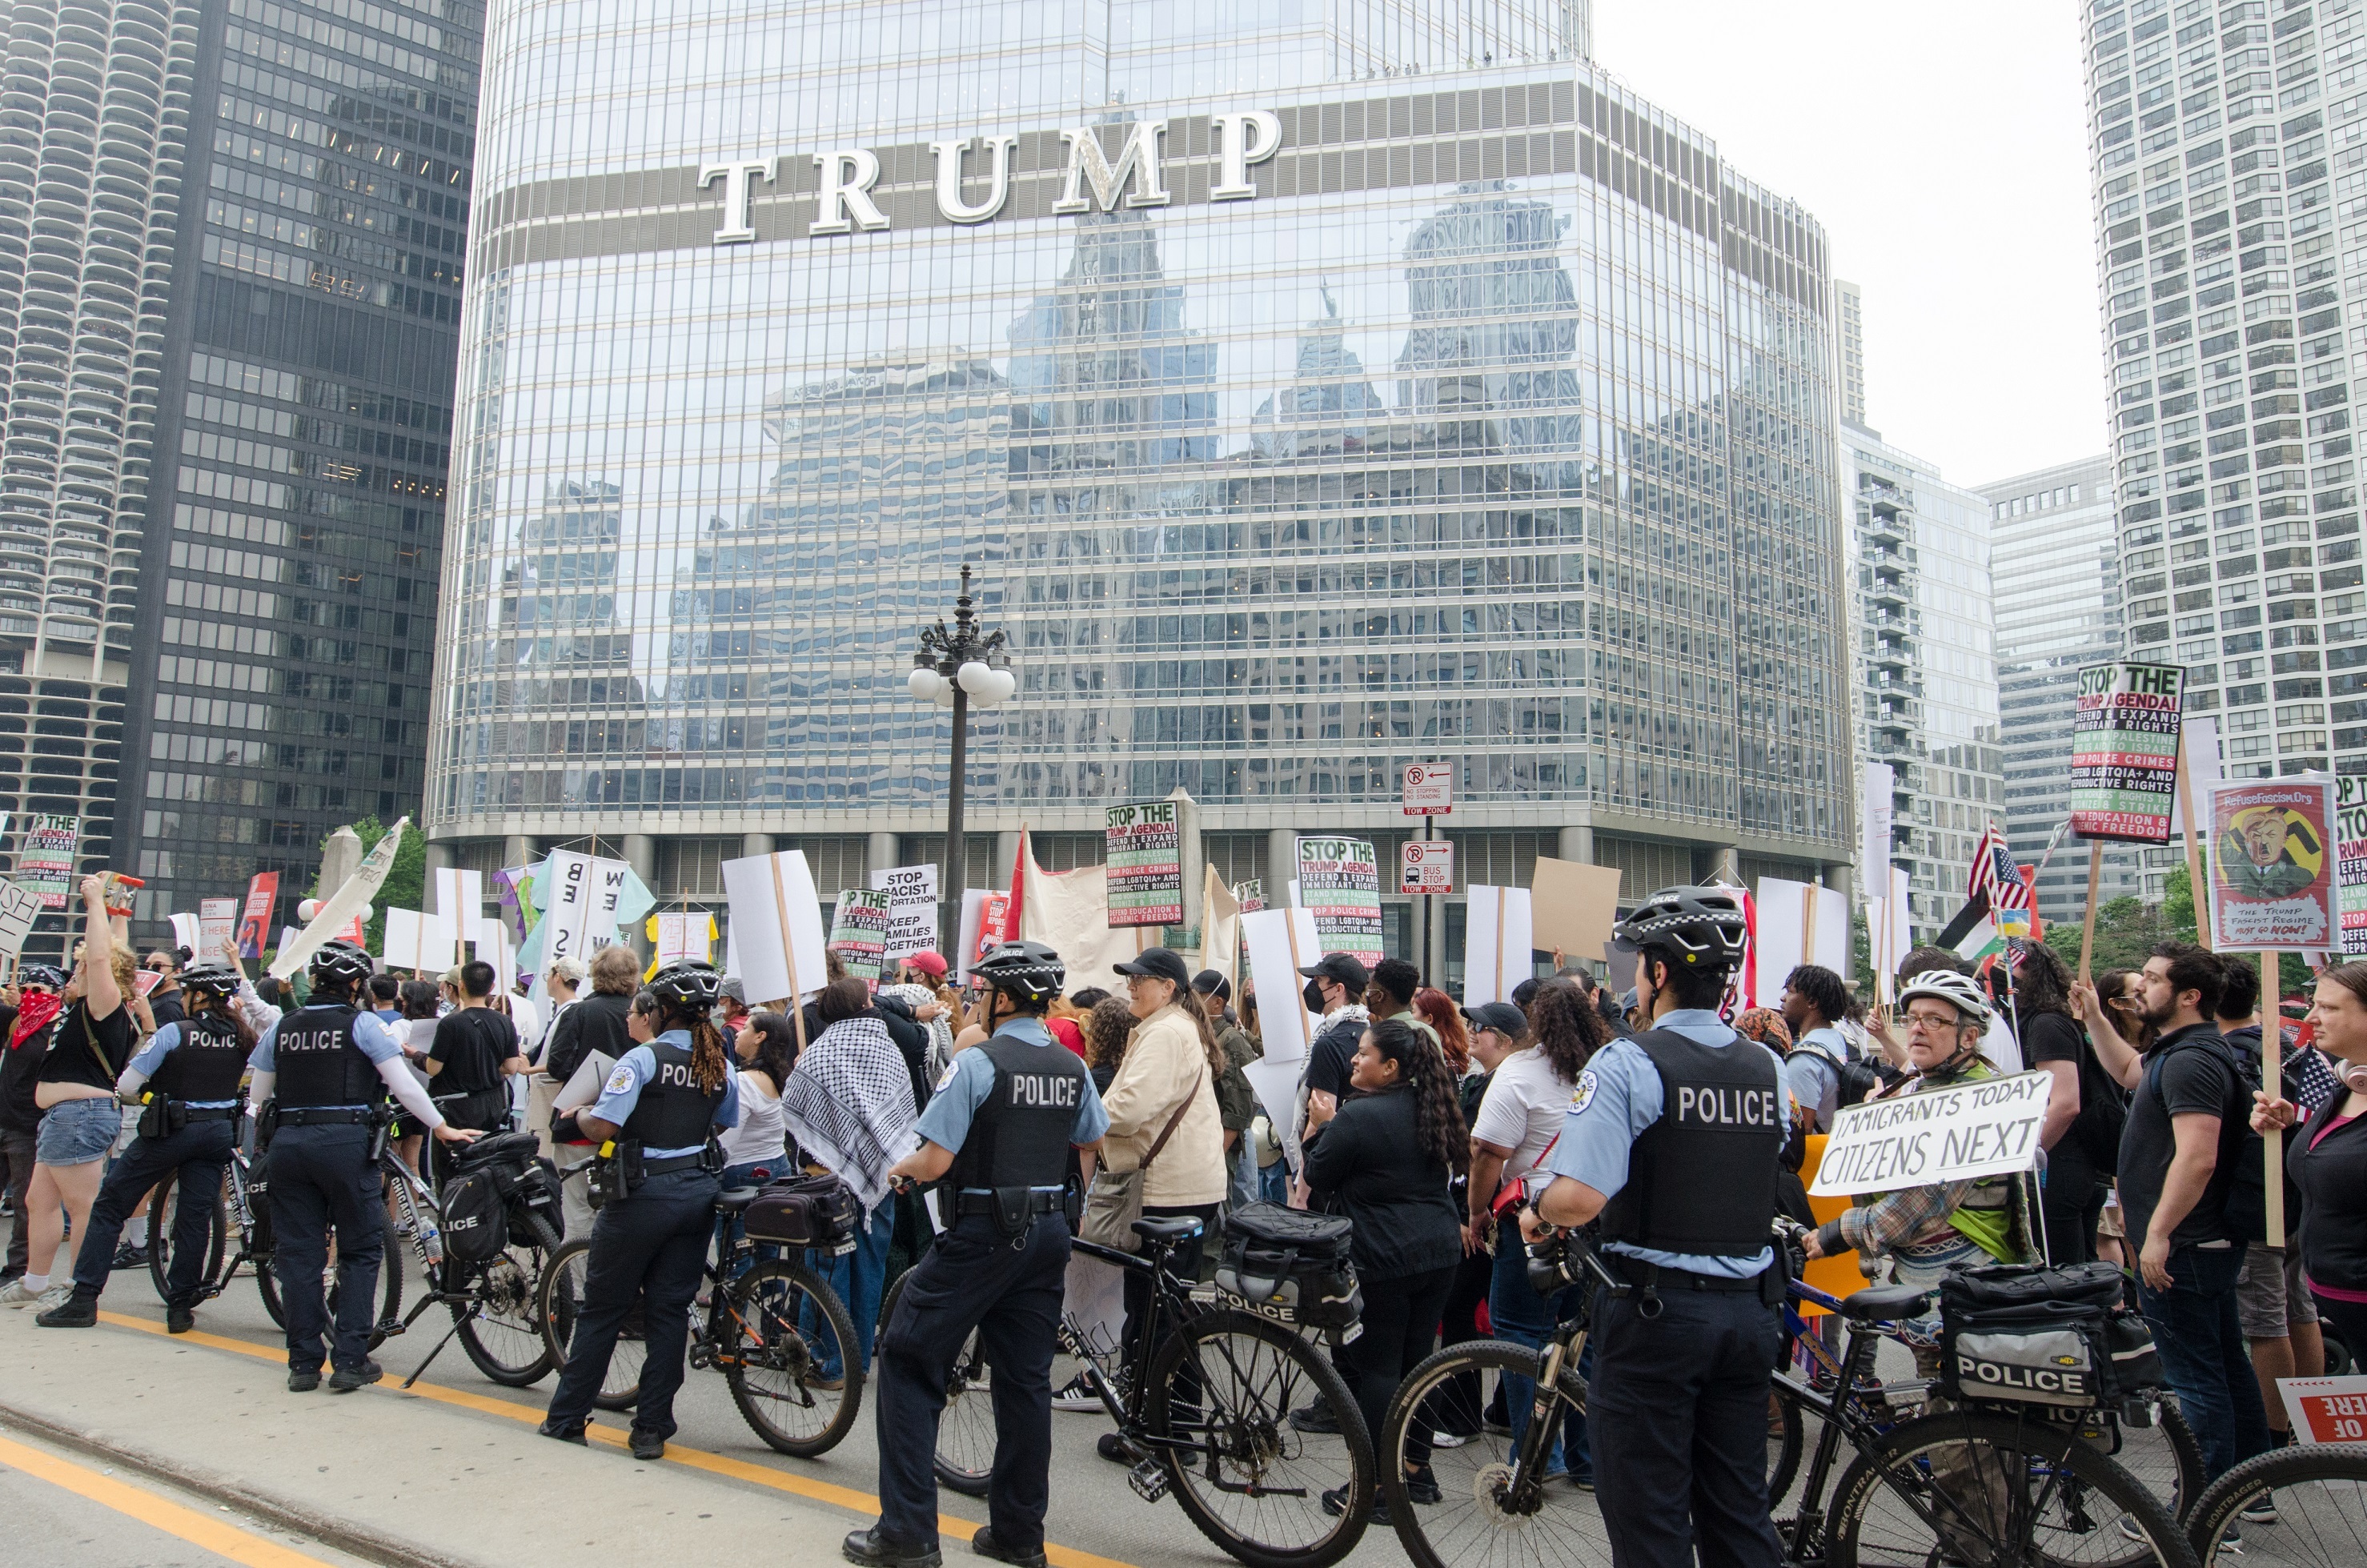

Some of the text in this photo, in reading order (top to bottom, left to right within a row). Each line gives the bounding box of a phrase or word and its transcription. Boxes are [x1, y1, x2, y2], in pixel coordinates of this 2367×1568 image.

[697, 110, 1282, 244] TRUMP
[2079, 667, 2178, 696] STOP THE
[2078, 693, 2176, 711] TRUMP AGENDA!
[2076, 710, 2179, 723] DEFEND & EXPAND
[2075, 720, 2178, 734] IMMIGRANT RIGHTS
[2093, 732, 2175, 745] WITH PALESTINE
[2111, 742, 2174, 755] TO ISRAEL
[2073, 754, 2174, 768] STOP POLICE CRIMES
[2092, 767, 2174, 782] LGBTQIA+ AND
[2072, 778, 2171, 792] REPRODUCTIVE RIGHTS
[2119, 792, 2170, 804] RIGHTS TO
[2119, 802, 2169, 814] STRIKE
[1108, 804, 1173, 828] STOP THE
[2088, 812, 2167, 827] EDUCATION &
[47, 816, 76, 830] THE
[2102, 822, 2166, 837] FREEDOM
[38, 829, 75, 839] AGENDA!
[1108, 822, 1175, 838] TRUMP AGENDA!
[1107, 833, 1177, 846] DEFEND EXPAND
[1107, 840, 1178, 853] IMMIGRANT RIGHTS
[1302, 842, 1374, 862] STOP THE
[1124, 848, 1177, 859] WITH PALESTINE
[1151, 854, 1177, 863] ISRAEL
[1122, 866, 1145, 874] POLICE
[1149, 864, 1179, 873] CRIMES
[1302, 861, 1375, 874] TRUMP AGENDA!
[1424, 866, 1441, 874] BUS
[887, 872, 923, 885] STOP
[1108, 878, 1125, 886] DEFEND
[1302, 873, 1338, 881] DEFEND
[1352, 874, 1378, 883] EXPAND
[1423, 875, 1445, 884] STOP
[1108, 882, 1179, 893] REPRODUCTIVE RIGHTS
[1246, 881, 1260, 898] THE
[1356, 882, 1379, 891] RIGHTS
[2340, 887, 2366, 899] STAND
[861, 892, 889, 909] THE
[892, 895, 936, 906] ORTATION
[1351, 891, 1379, 899] PALESTINE
[1649, 895, 1680, 905] POLICE
[1109, 900, 1135, 908] UNIONIZE
[1129, 906, 1171, 914] EDUCATION
[2341, 900, 2357, 911] END
[849, 906, 887, 918] AGENDA!
[989, 907, 1004, 917] STOP
[1109, 913, 1181, 923] ACADEMIC FREEDOM
[1359, 908, 1380, 916] CRIMES
[857, 916, 888, 925] EXPAND
[889, 916, 920, 928] KEEP
[1339, 917, 1370, 925] LGBTQIA+
[1371, 918, 1382, 926] AND
[2273, 916, 2314, 924] REGIME
[2341, 913, 2365, 925] STOP
[209, 926, 231, 935] HERE
[851, 929, 885, 938] PALESTINE
[887, 926, 931, 939] AMILIES
[1317, 925, 1382, 934] PRODUCTIVE RIGHTS
[2235, 927, 2255, 935] MUST
[2270, 925, 2307, 935] NOW!
[857, 942, 883, 951] CRIMES
[884, 937, 935, 951] OGETHER
[852, 970, 879, 978] STRIKE
[190, 1031, 237, 1048] POLIC
[280, 1031, 343, 1052] POLICE
[1013, 1075, 1077, 1106] POLICE
[1679, 1087, 1774, 1125] POLICE
[1835, 1076, 2048, 1140] IMMIGRANTS TODAY
[1820, 1117, 2038, 1185] CITIZENS NEXT
[391, 1177, 427, 1265] CHICAGO POLICE
[443, 1216, 478, 1232] LICE
[1218, 1286, 1295, 1321] POLICE
[1958, 1356, 2084, 1394] POLICE
[2334, 1419, 2363, 1438] OF
[2208, 1478, 2263, 1529] BONTRAGER
